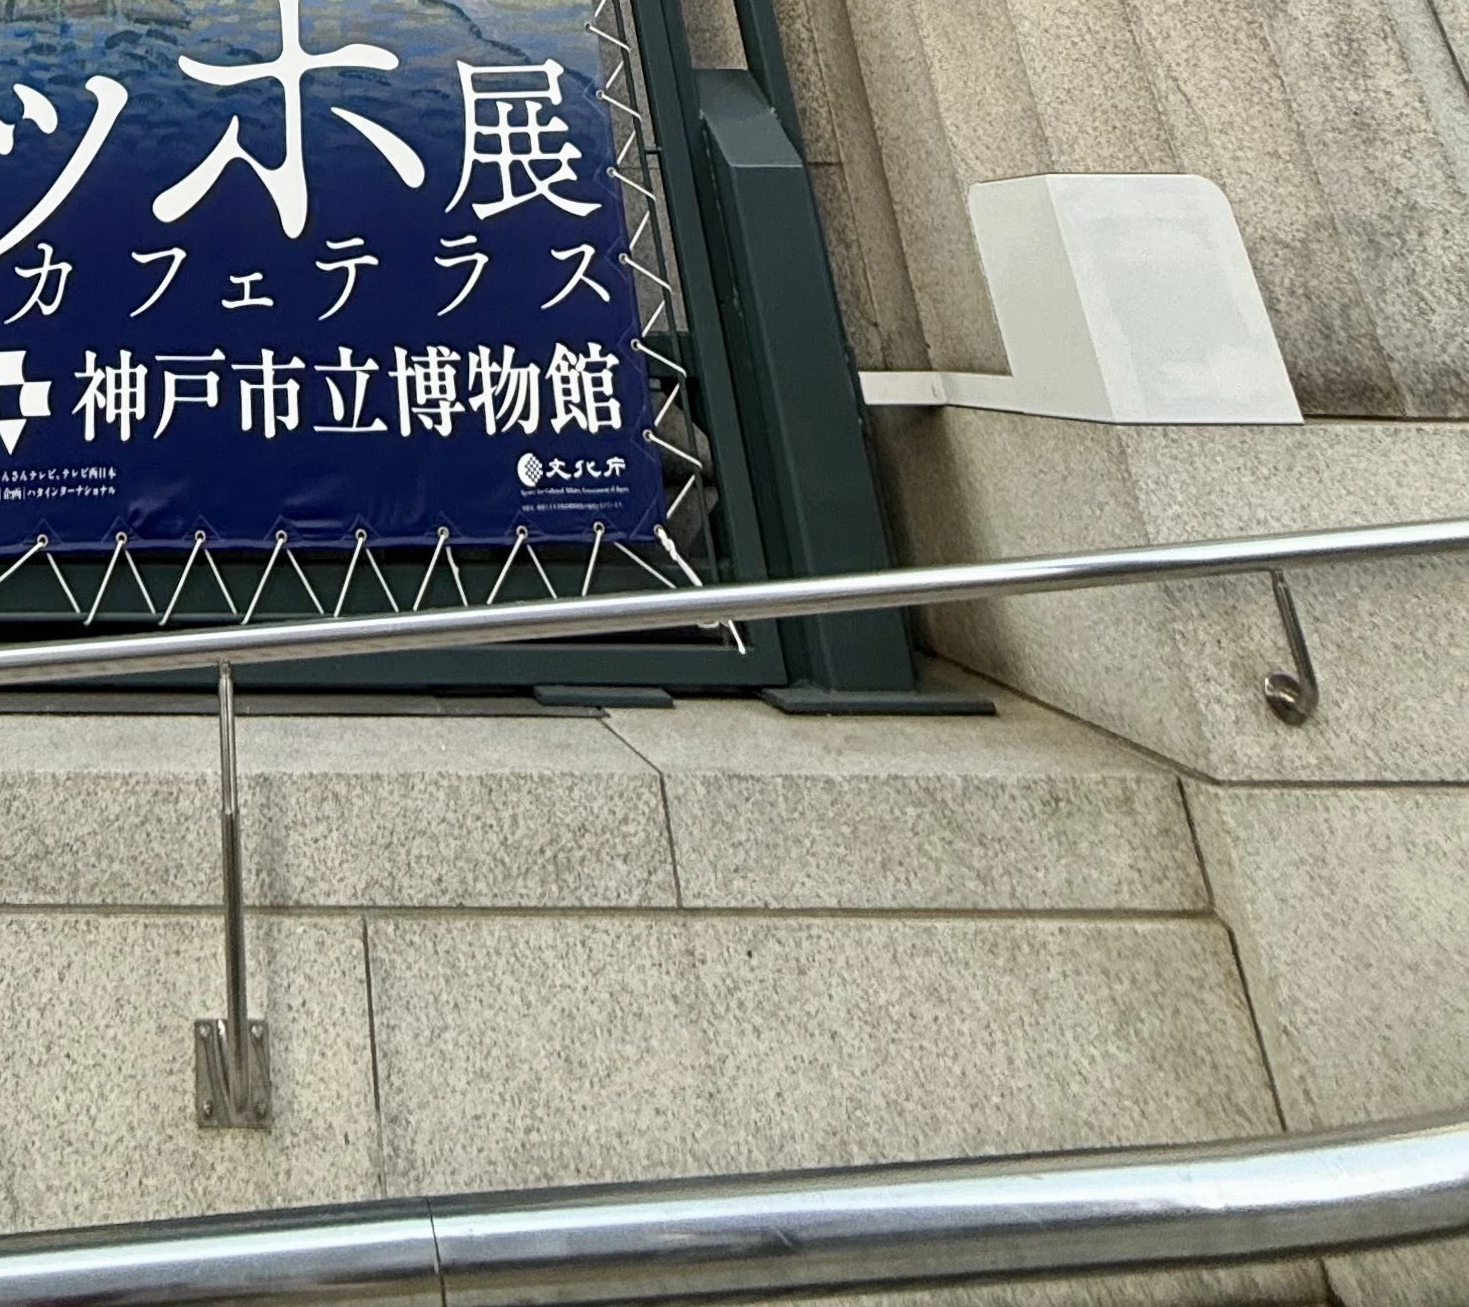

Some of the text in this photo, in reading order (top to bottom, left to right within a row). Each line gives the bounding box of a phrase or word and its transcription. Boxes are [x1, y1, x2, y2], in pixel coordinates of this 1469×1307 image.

[71, 342, 622, 442] 神戸市立博物館
[545, 456, 627, 481] 文化庁
